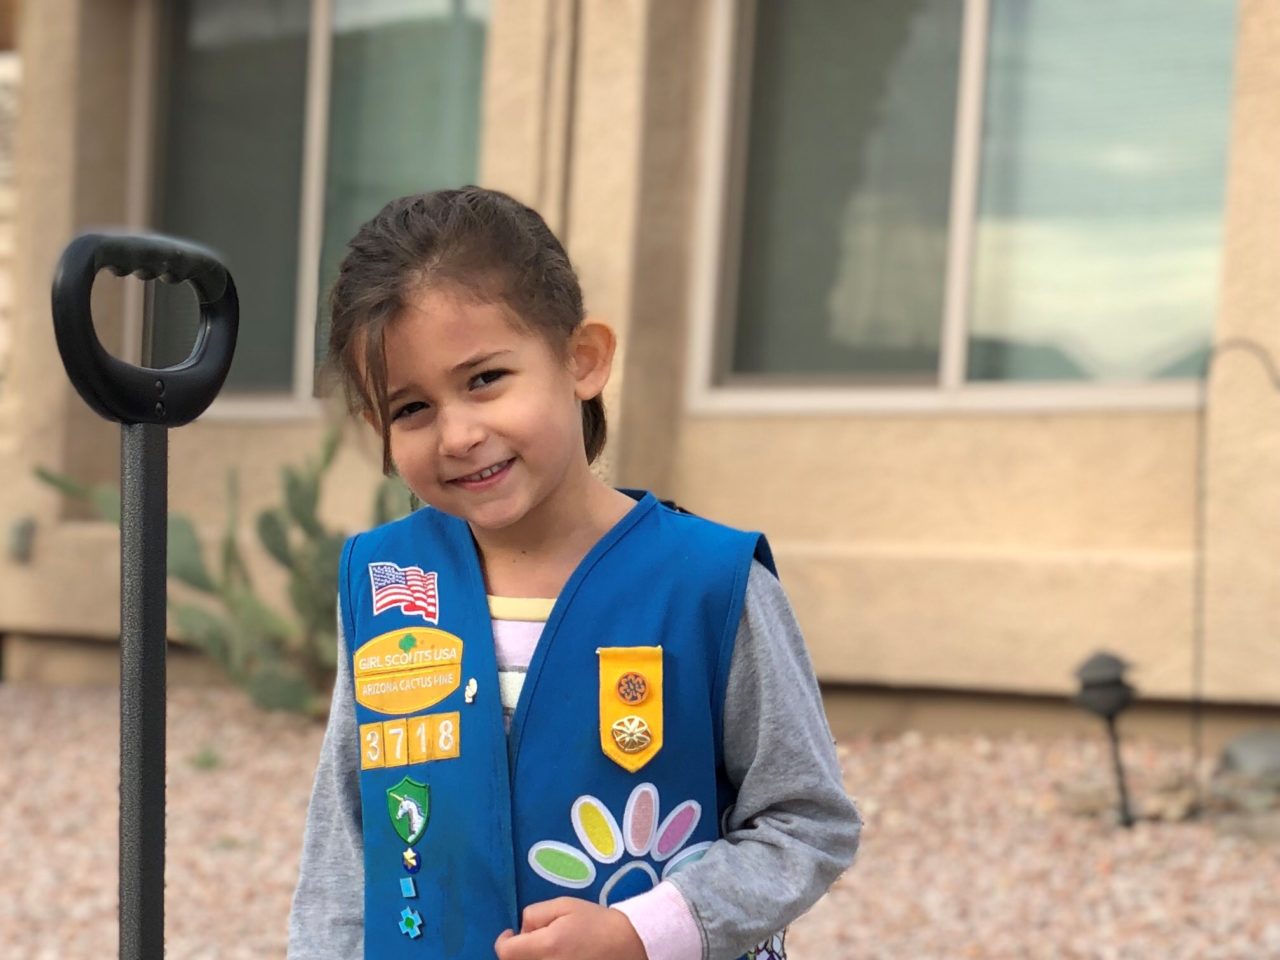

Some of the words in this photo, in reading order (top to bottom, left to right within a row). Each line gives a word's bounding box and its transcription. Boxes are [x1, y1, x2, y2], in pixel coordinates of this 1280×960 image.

[358, 655, 383, 670] GIRL
[384, 649, 432, 667] SCOUTS
[434, 647, 458, 661] USA
[362, 682, 398, 697] ARIZONA
[399, 675, 433, 692] CACTUS
